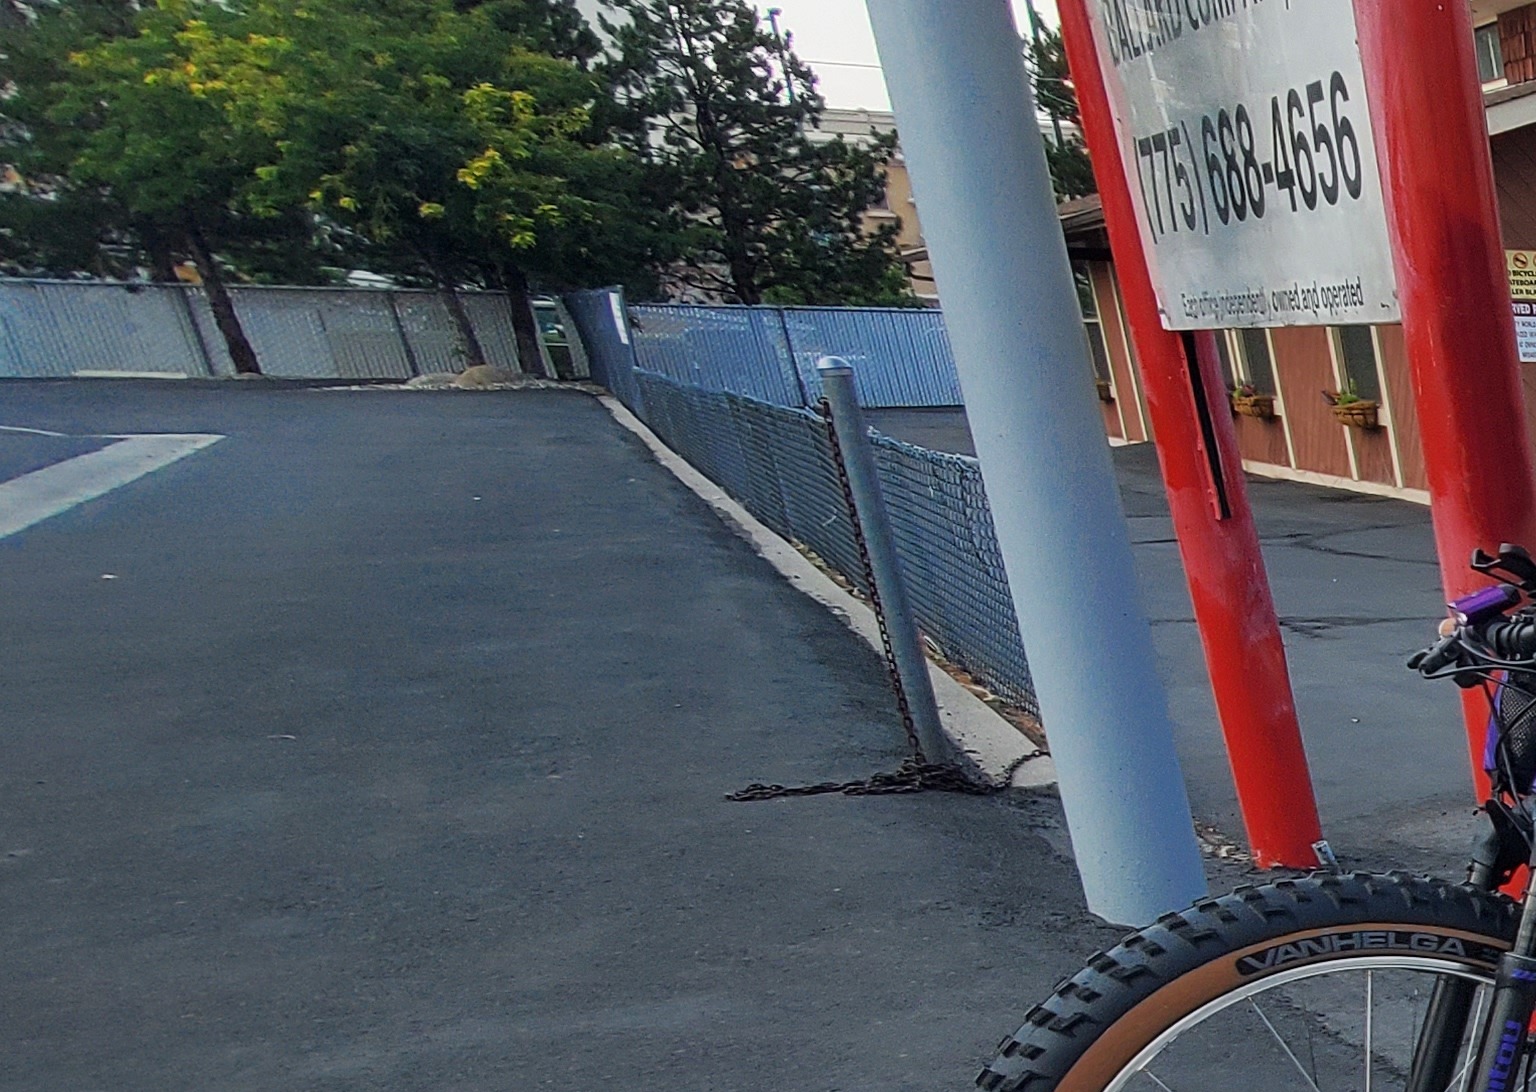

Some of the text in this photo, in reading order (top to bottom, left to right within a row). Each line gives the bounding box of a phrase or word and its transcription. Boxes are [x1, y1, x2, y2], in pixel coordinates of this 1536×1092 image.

[1133, 71, 1362, 245] (775) 688-4656
[1320, 276, 1364, 316] operated
[1244, 931, 1466, 970] VANHELGA
